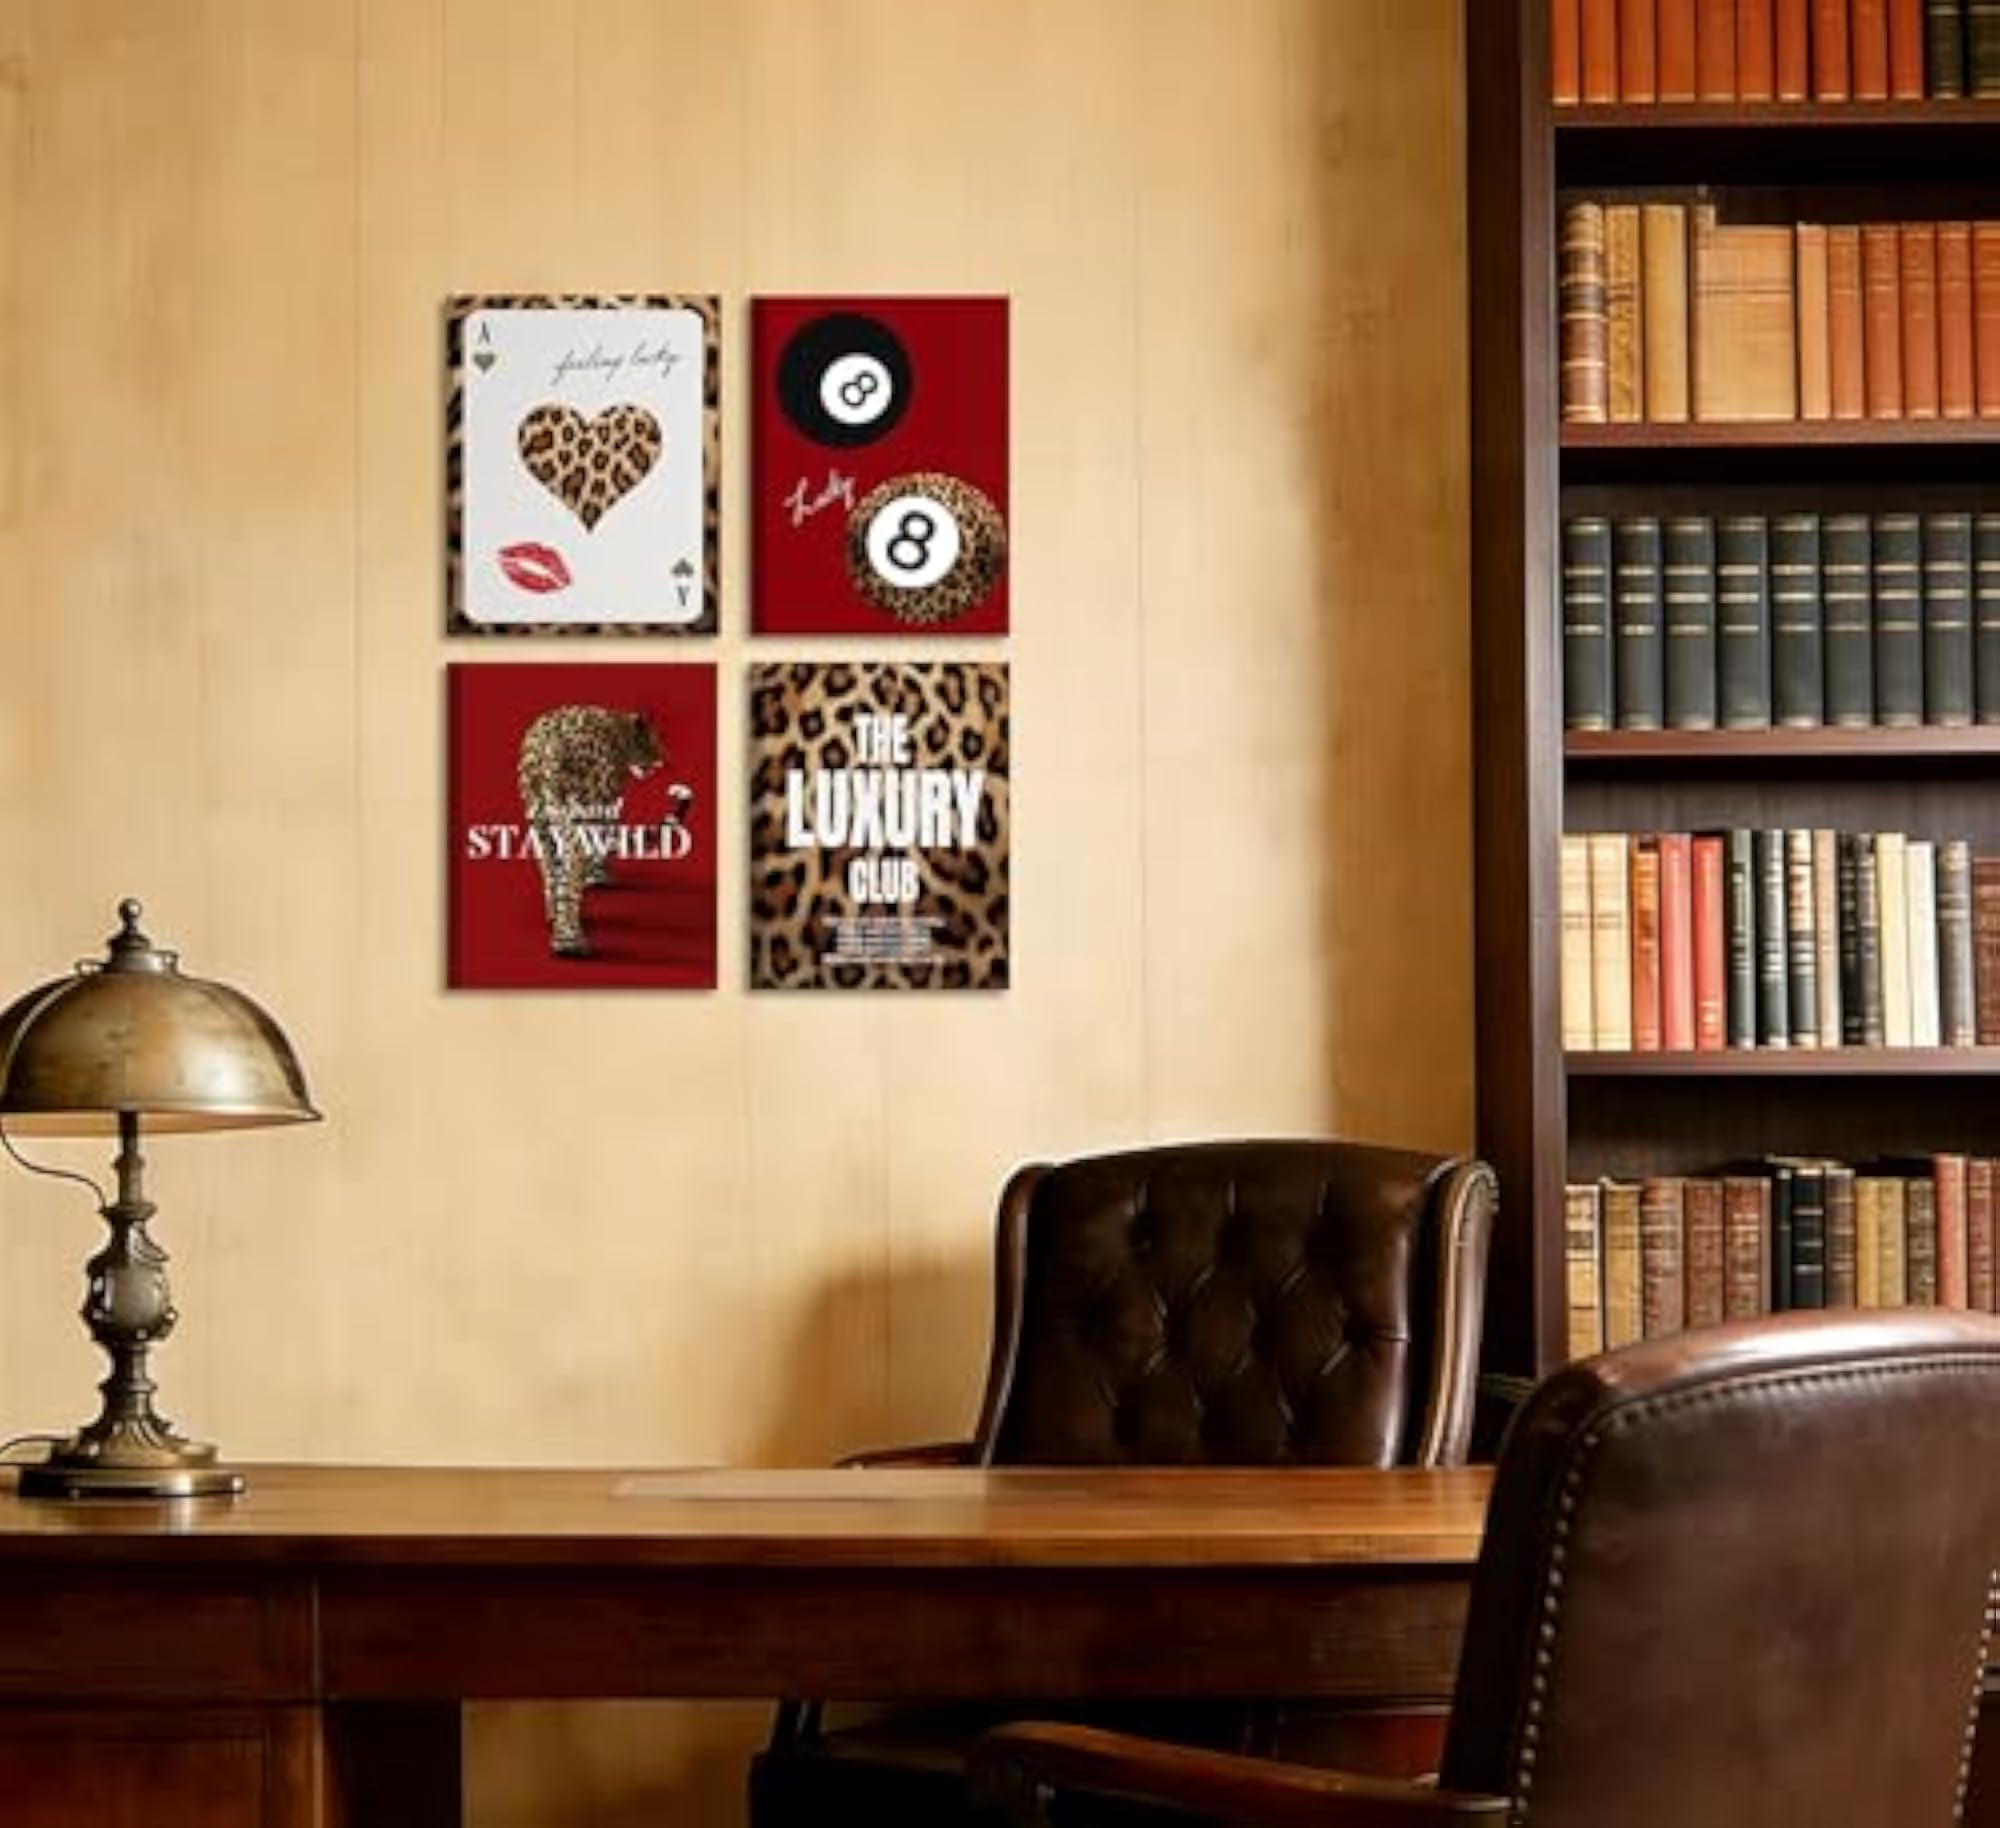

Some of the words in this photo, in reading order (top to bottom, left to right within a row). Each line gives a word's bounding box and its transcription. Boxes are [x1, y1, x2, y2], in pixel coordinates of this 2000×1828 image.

[840, 370, 879, 409] 8
[887, 510, 936, 571] 8
[854, 712, 911, 764] THE
[787, 768, 984, 848] LUXURY
[849, 858, 920, 904] CLUB
